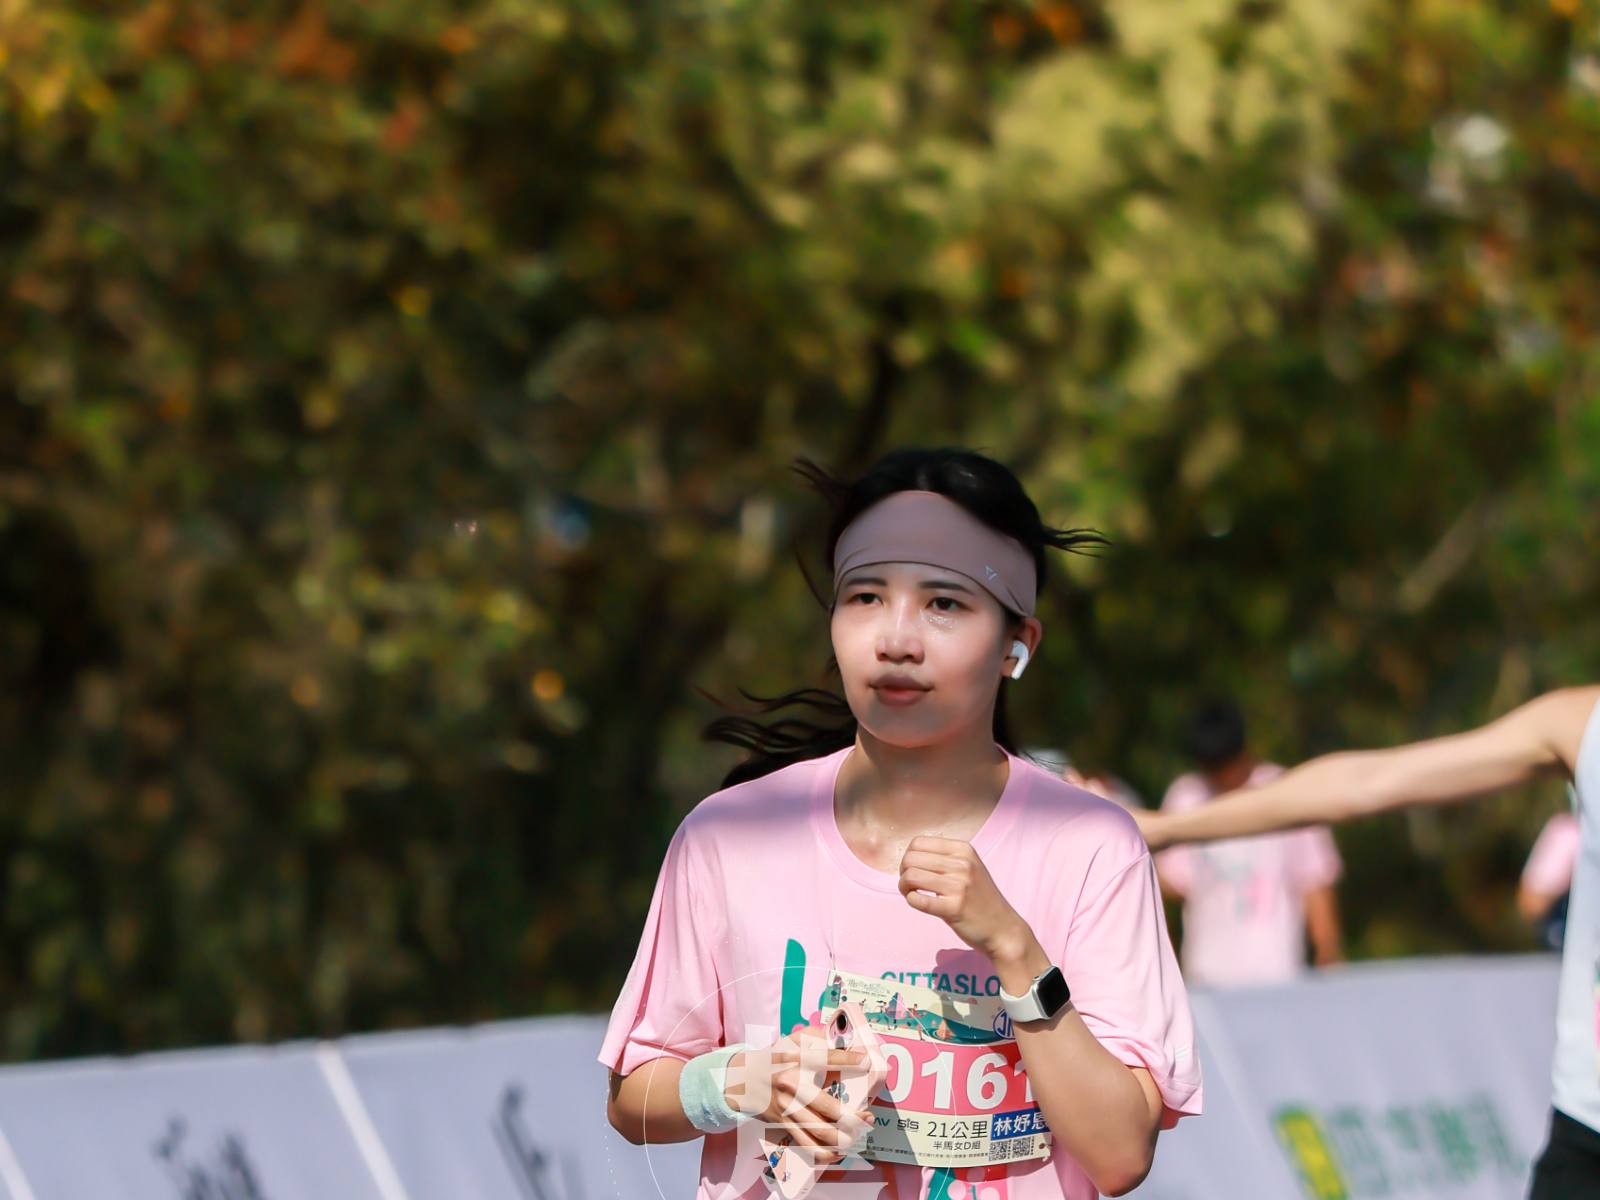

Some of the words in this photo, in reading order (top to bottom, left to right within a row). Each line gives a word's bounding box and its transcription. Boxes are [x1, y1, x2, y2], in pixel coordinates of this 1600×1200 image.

[926, 1120, 987, 1139] 21公里
[932, 1140, 981, 1151] 半馬女D組
